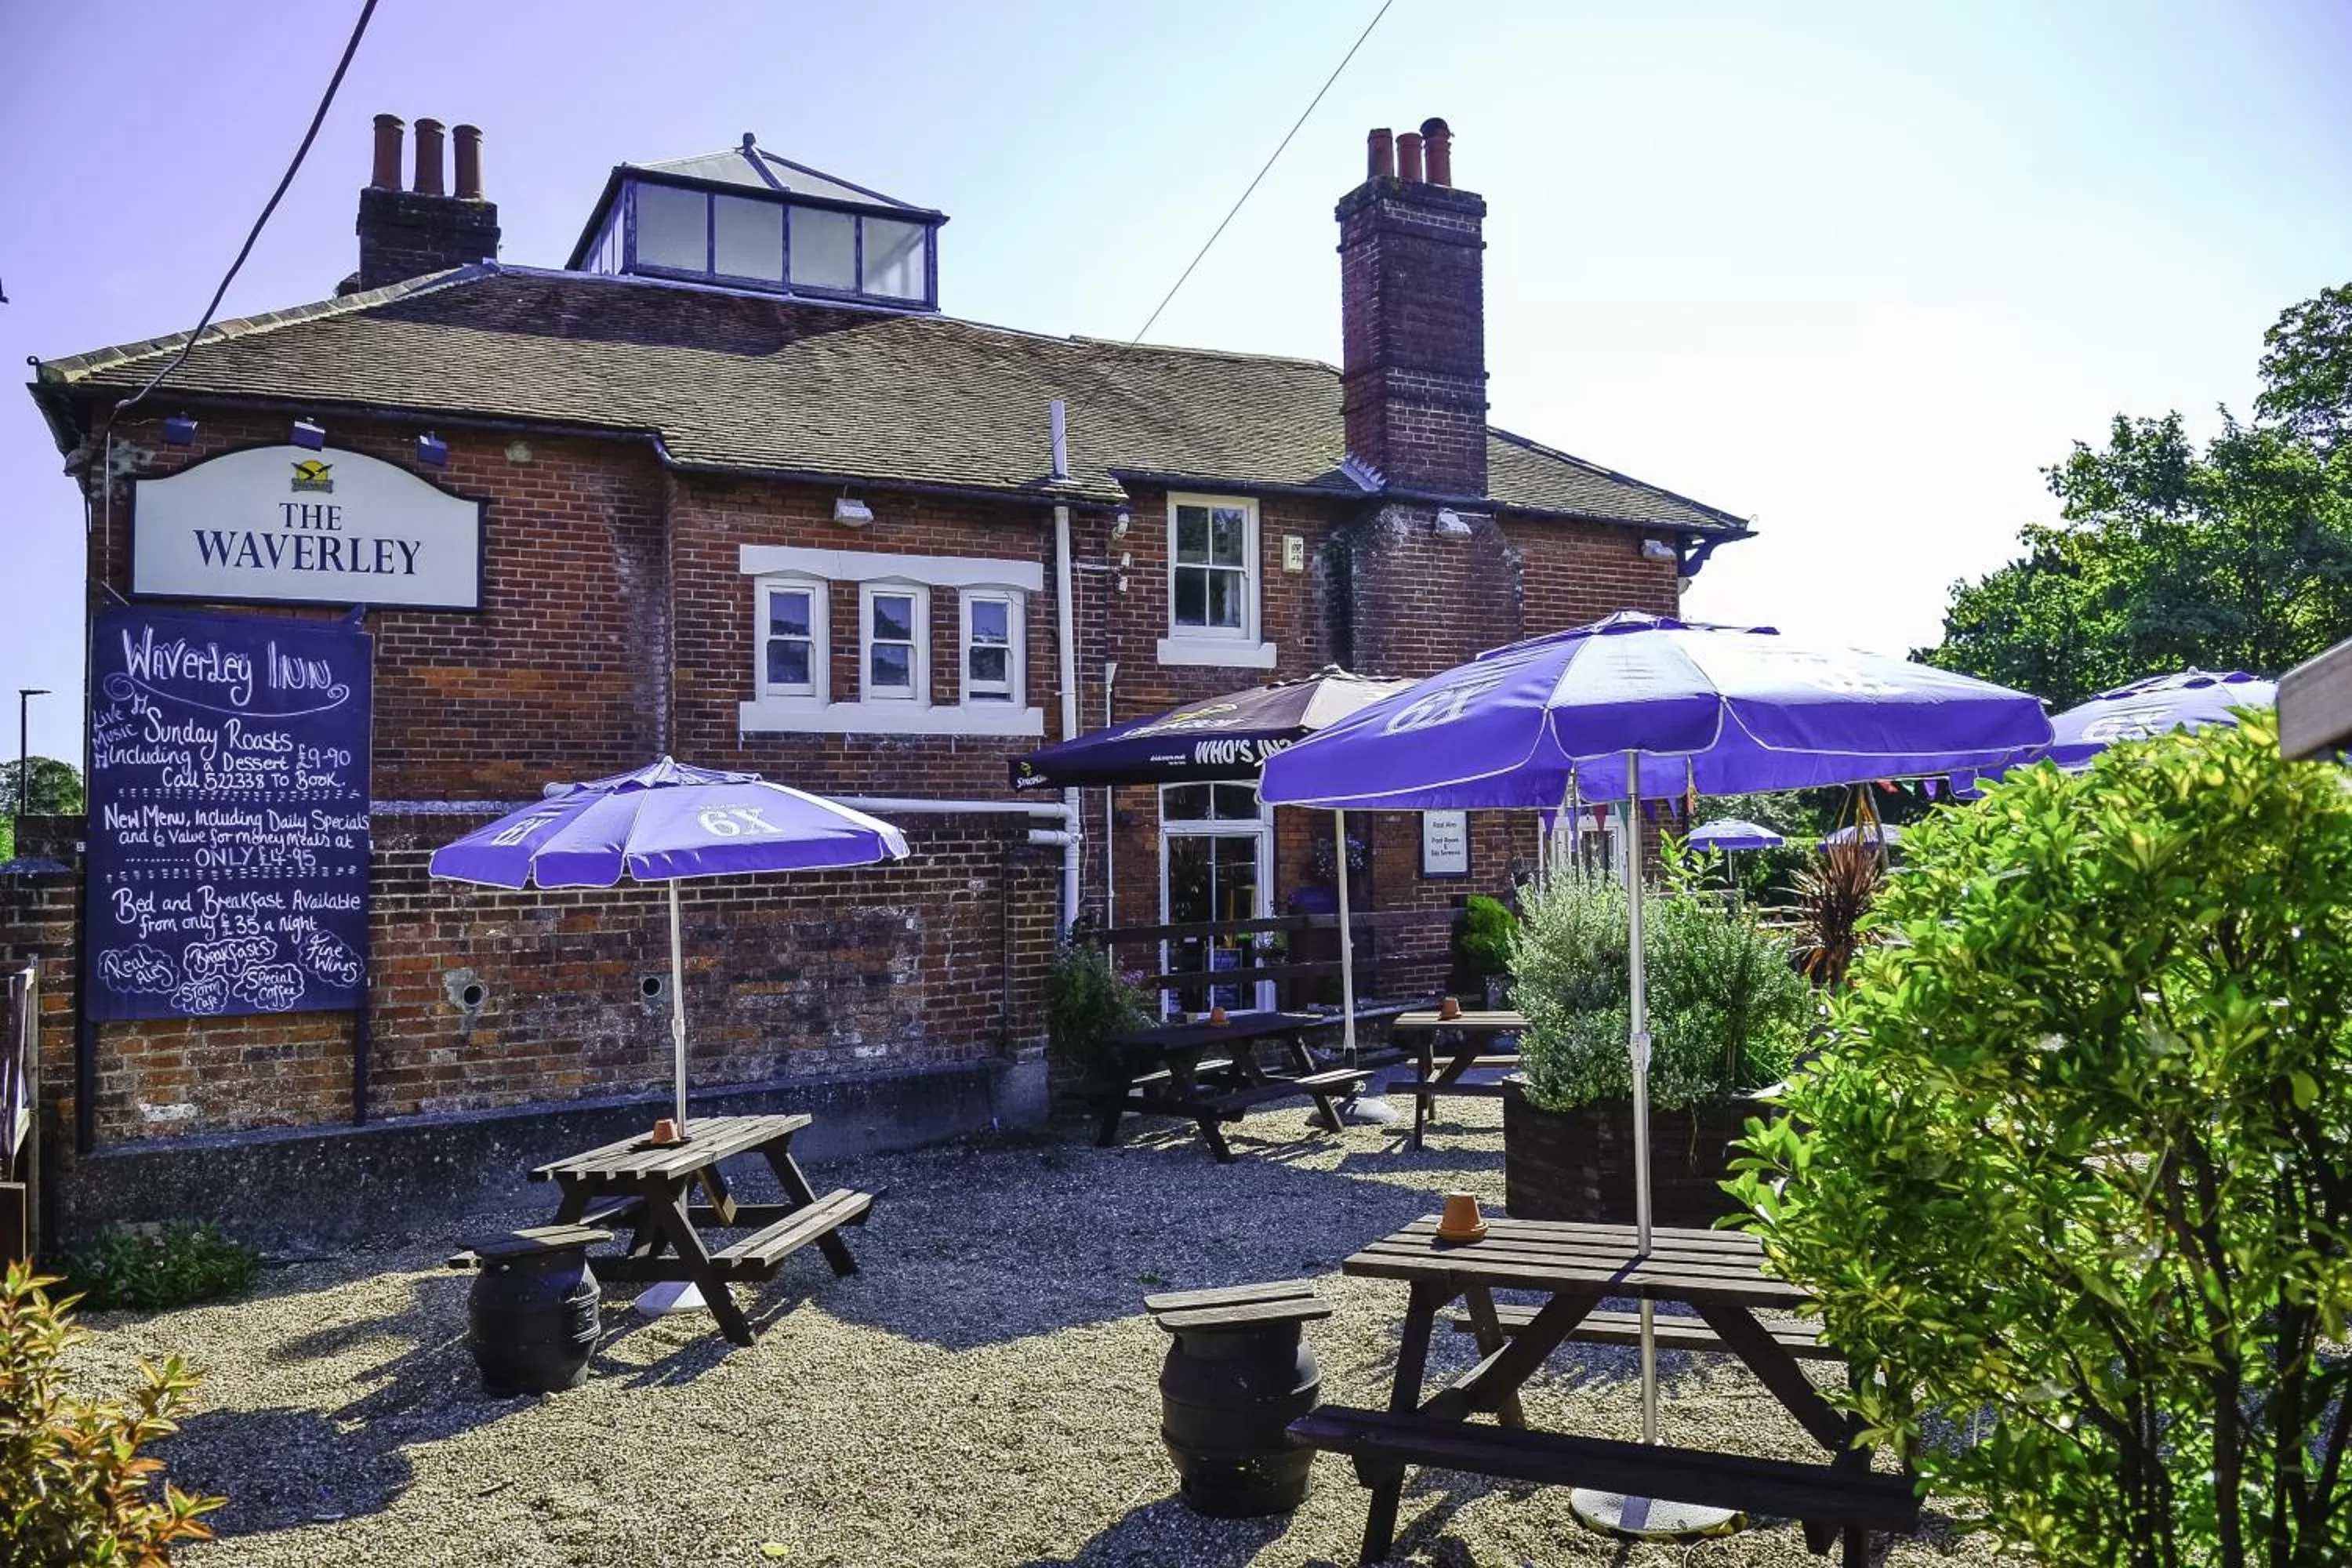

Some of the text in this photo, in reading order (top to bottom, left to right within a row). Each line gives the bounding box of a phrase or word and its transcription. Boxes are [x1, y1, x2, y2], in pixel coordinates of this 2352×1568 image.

[278, 502, 343, 531] THE
[192, 529, 421, 575] WAVERLEY
[144, 706, 293, 762] Sunday Roasts
[108, 744, 191, 776] Including
[203, 760, 213, 771] a
[223, 752, 289, 771] Dessert
[1194, 739, 1254, 765] WHO'S
[162, 766, 200, 789] Call
[204, 772, 265, 790] 522338
[103, 802, 140, 830] New
[195, 806, 263, 837] Including
[267, 808, 307, 838] Daily
[311, 808, 370, 833] Specials
[698, 808, 784, 837] 6X
[118, 828, 150, 844] and
[168, 828, 206, 844] Value
[209, 827, 234, 849] for
[235, 827, 285, 856] money
[286, 832, 330, 848] meals
[335, 833, 355, 850] at
[195, 847, 253, 867] ONLY
[111, 885, 361, 924] Bed and Breakfast Available
[139, 914, 179, 939] from
[181, 916, 216, 941] only
[264, 920, 275, 931] a
[278, 916, 318, 945] night
[105, 949, 153, 979] Real
[190, 943, 271, 973] Breakfasts
[314, 956, 358, 982] Wines
[245, 970, 295, 989] Special
